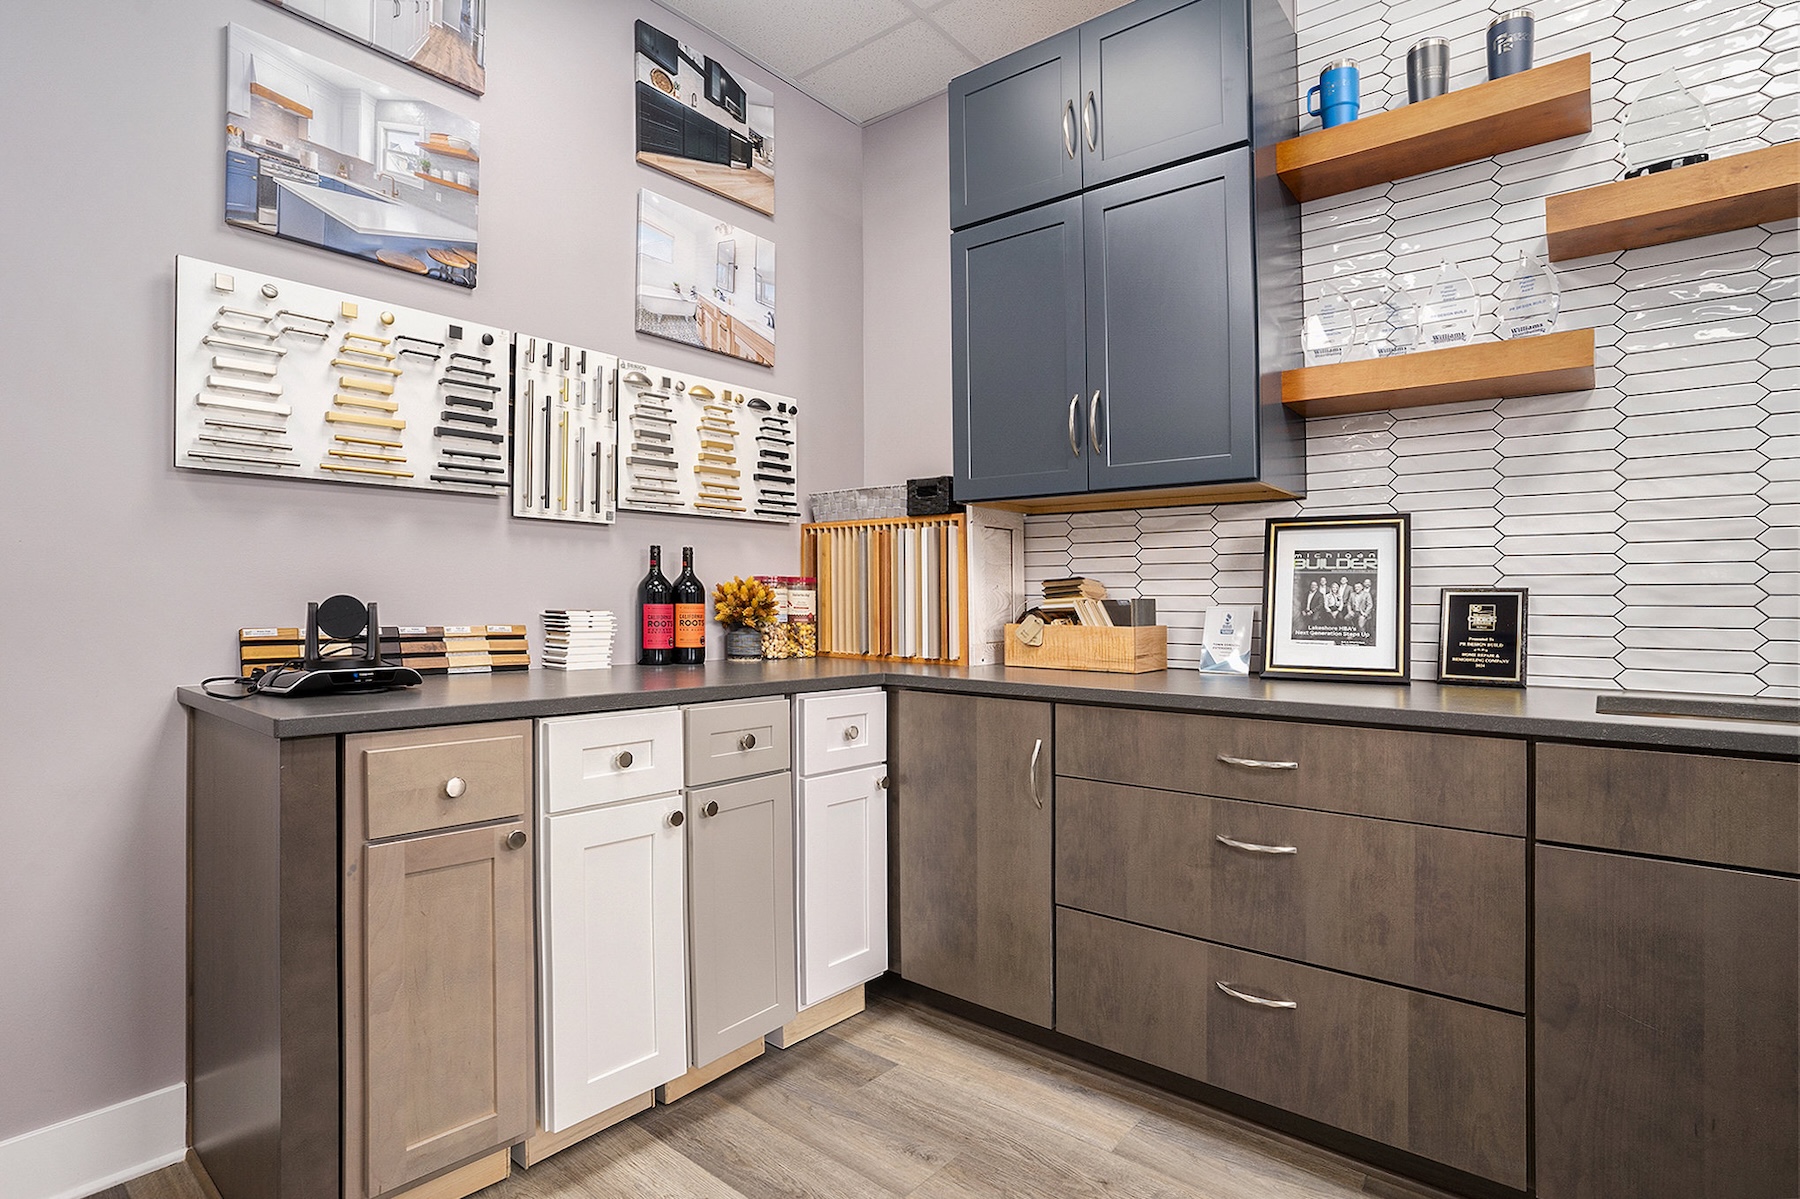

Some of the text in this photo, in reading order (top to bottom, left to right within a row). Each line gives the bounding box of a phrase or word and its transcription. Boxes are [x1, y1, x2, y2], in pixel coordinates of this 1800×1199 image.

[1511, 323, 1544, 333] Williams
[1432, 332, 1466, 340] Williams
[1294, 558, 1378, 569] BUILDER
